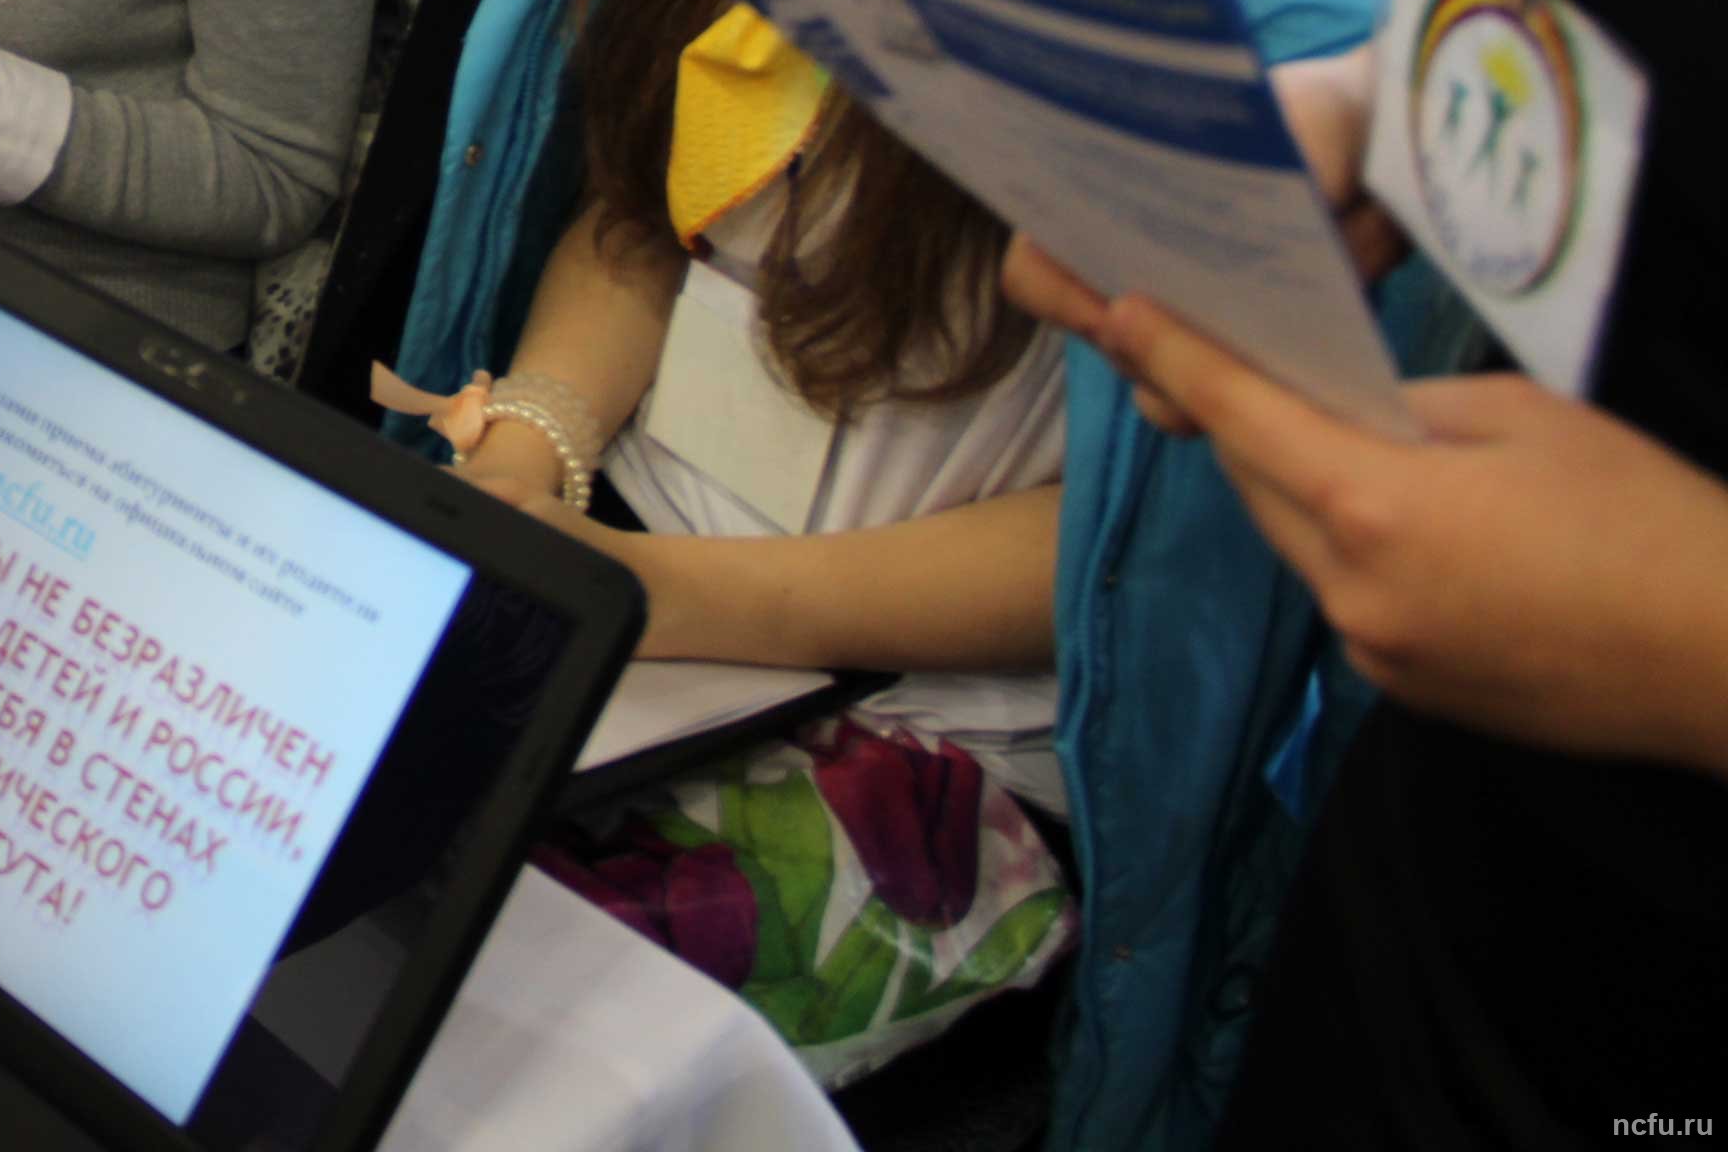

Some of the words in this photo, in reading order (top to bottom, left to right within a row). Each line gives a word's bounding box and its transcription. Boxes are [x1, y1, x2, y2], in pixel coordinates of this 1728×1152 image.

[18, 563, 72, 618] НЕ
[71, 596, 335, 788] БЕЗРАЗЛИЧЕН
[47, 728, 76, 768] В
[80, 752, 230, 875] СТЕНАХ
[108, 695, 143, 742] И
[142, 719, 303, 861] РОССИИ,
